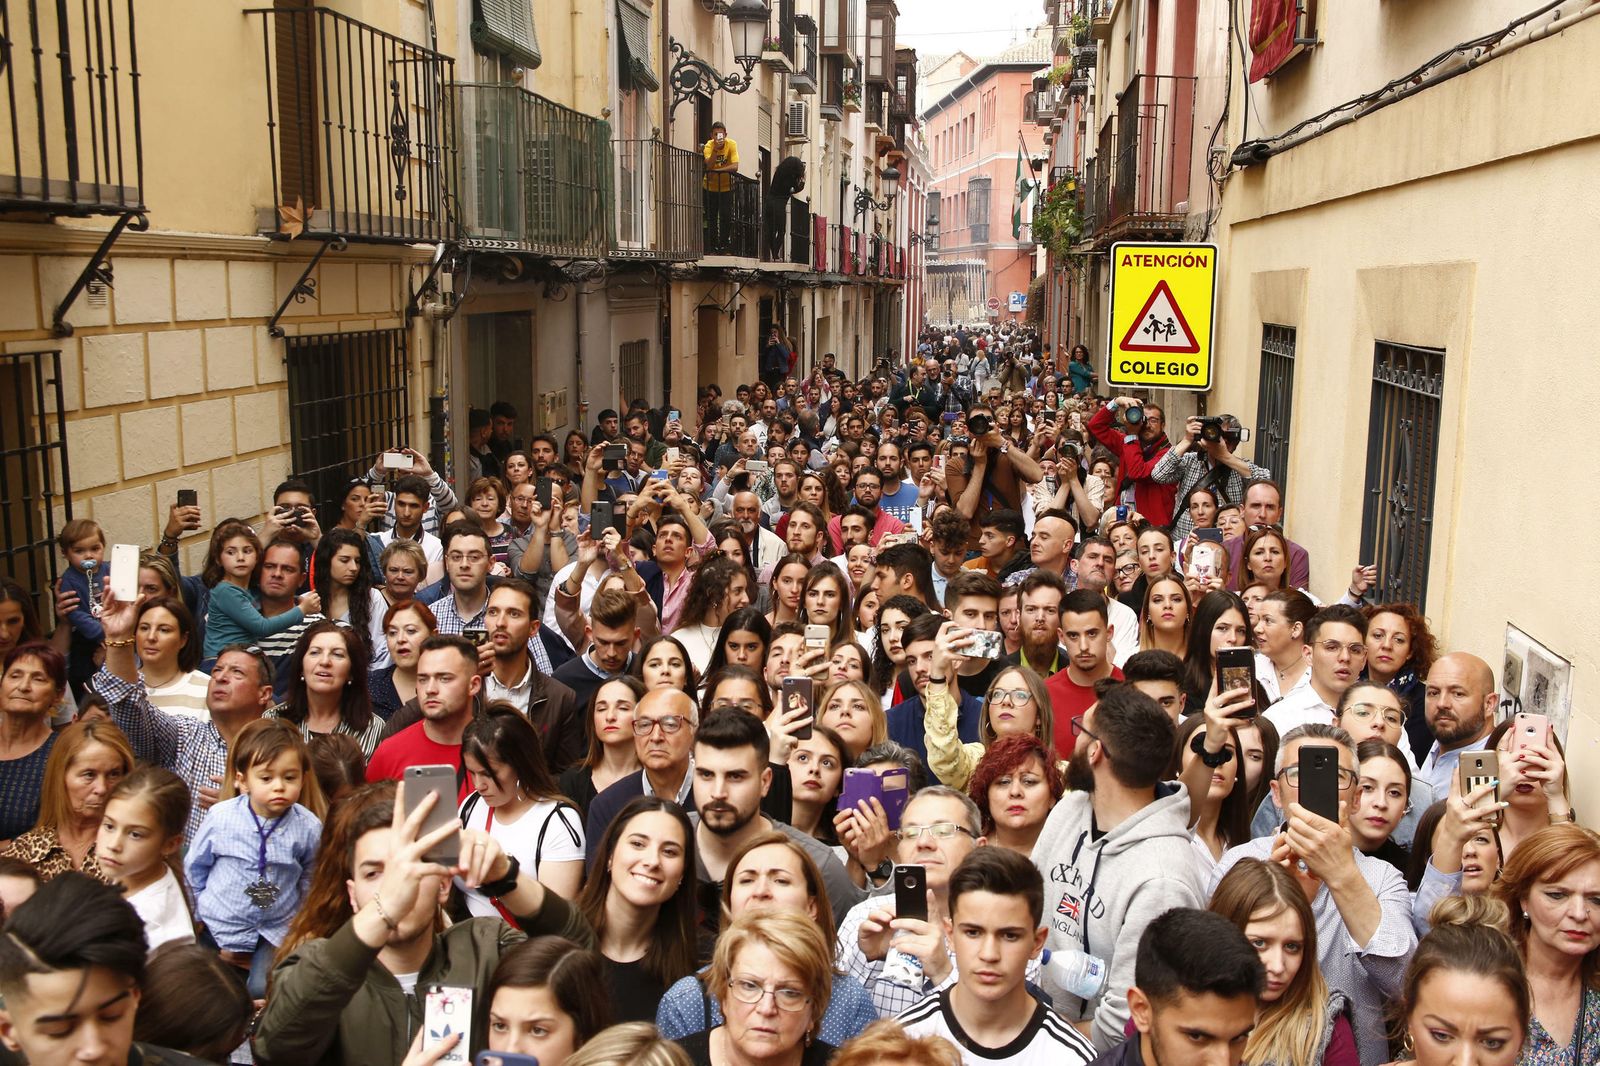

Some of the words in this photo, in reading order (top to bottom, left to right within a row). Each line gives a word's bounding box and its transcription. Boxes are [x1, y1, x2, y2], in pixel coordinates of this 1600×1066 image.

[1121, 251, 1208, 268] ATENCIÓN
[1119, 360, 1199, 377] COLEGIO
[1052, 917, 1084, 944] NGLAN
